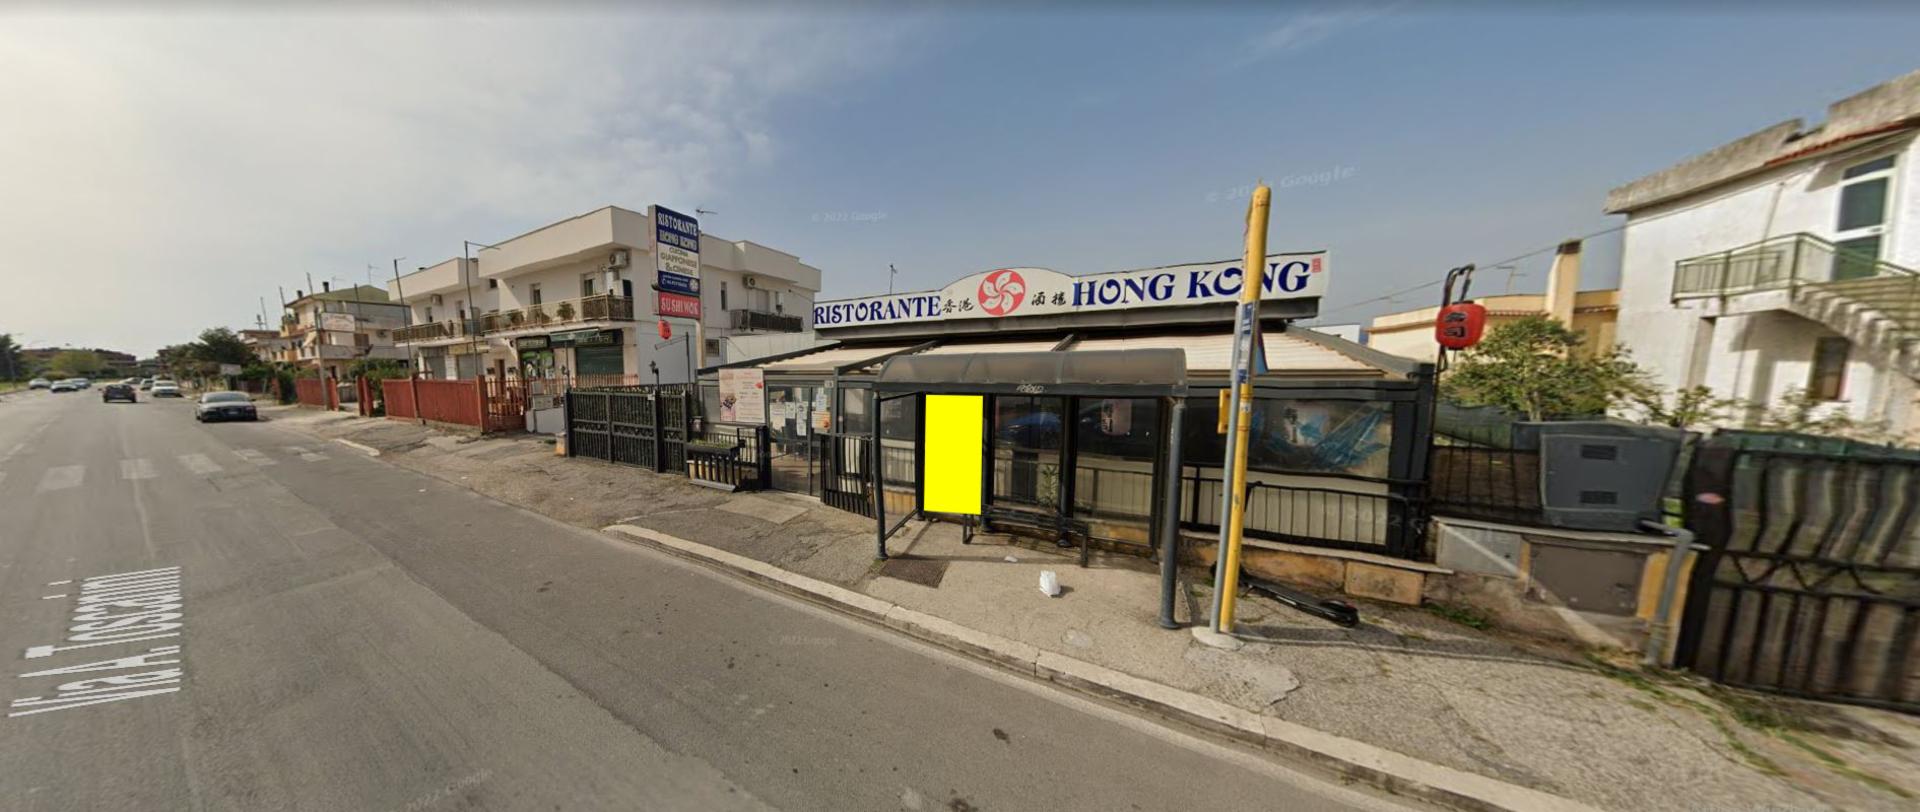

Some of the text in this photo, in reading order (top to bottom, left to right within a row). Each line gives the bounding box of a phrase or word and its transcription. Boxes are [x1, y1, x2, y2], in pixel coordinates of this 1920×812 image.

[658, 212, 698, 237] RISTORANTE
[1072, 272, 1176, 306] HONG
[814, 295, 942, 325] RISTORANTE
